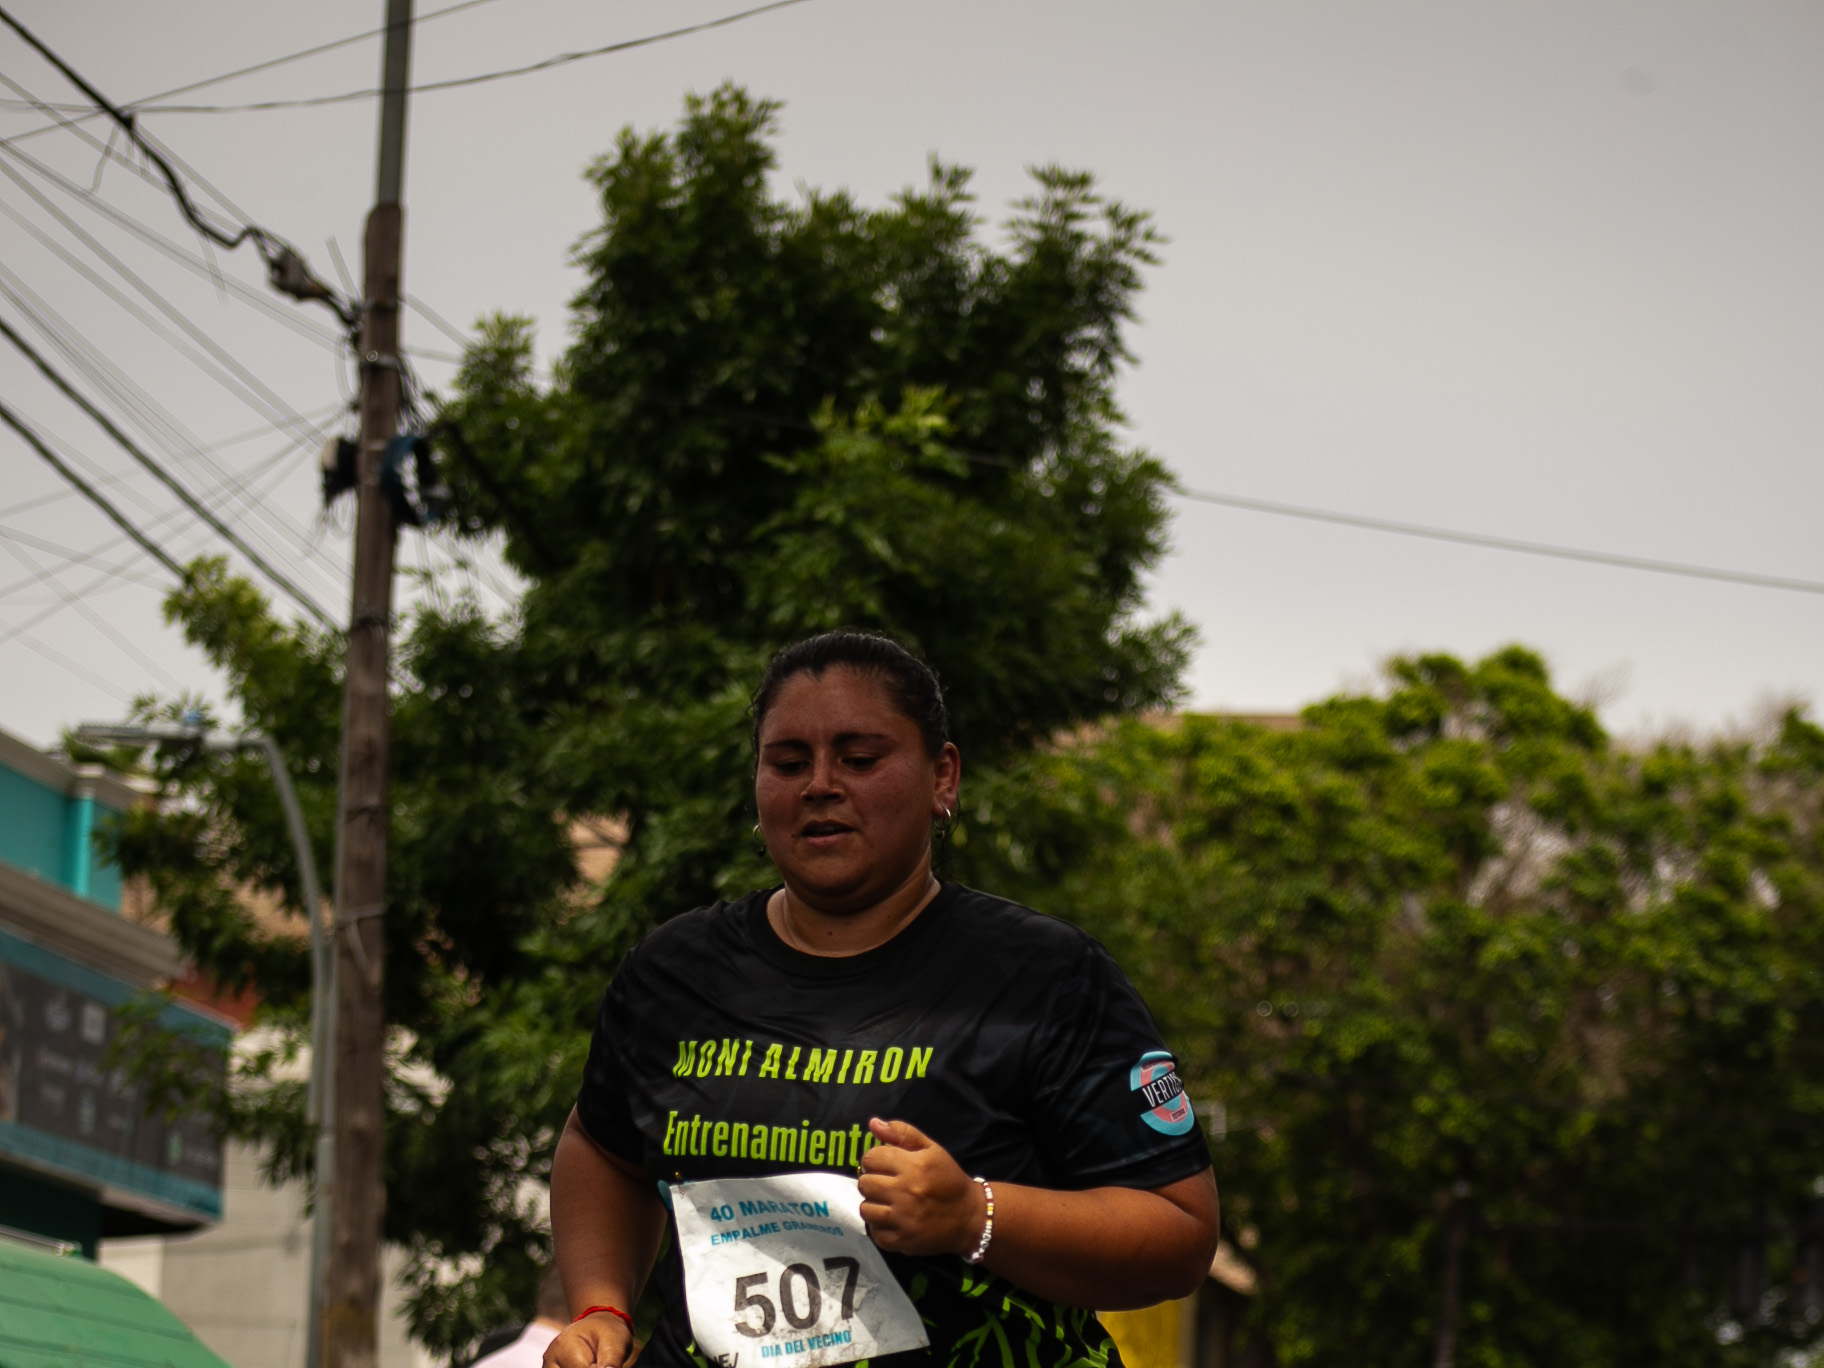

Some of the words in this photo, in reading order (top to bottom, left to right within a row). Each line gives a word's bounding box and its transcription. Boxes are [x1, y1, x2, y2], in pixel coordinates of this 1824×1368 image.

[673, 1038, 752, 1077] MONI
[759, 1043, 934, 1085] ALMIRON
[710, 1204, 734, 1222] 40
[739, 1200, 830, 1218] MARATON
[710, 1222, 780, 1246] EMPALME
[734, 1256, 861, 1339] 507
[761, 1346, 782, 1358] DIA
[785, 1340, 807, 1354] DEL
[808, 1329, 852, 1350] VECINO
